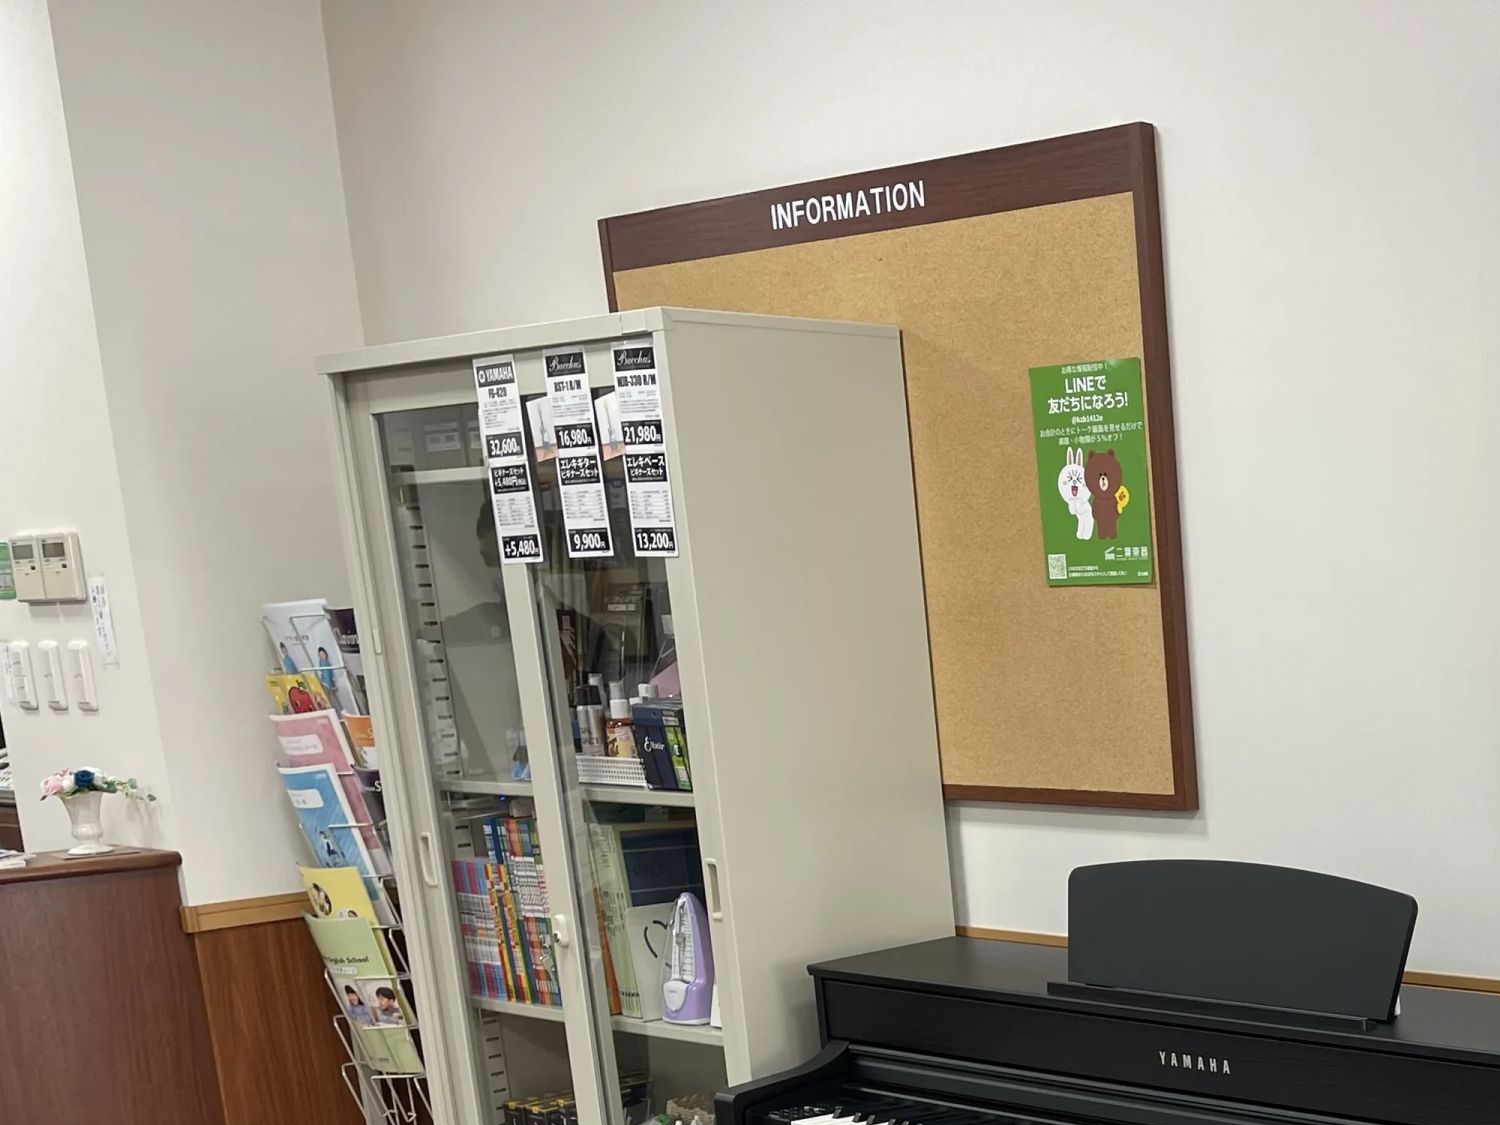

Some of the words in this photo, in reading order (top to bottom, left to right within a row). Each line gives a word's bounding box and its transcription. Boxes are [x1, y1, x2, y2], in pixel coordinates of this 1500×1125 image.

[770, 180, 925, 230] INFORMATION
[486, 367, 514, 382] YAMAHA
[1065, 376, 1107, 393] LINEで
[561, 459, 596, 470] エレキギター
[627, 456, 665, 467] エレキベース
[561, 468, 598, 479] ビギナーズセット
[630, 467, 663, 477] ビギナーズセット
[1159, 1051, 1230, 1075] YAMAHA
